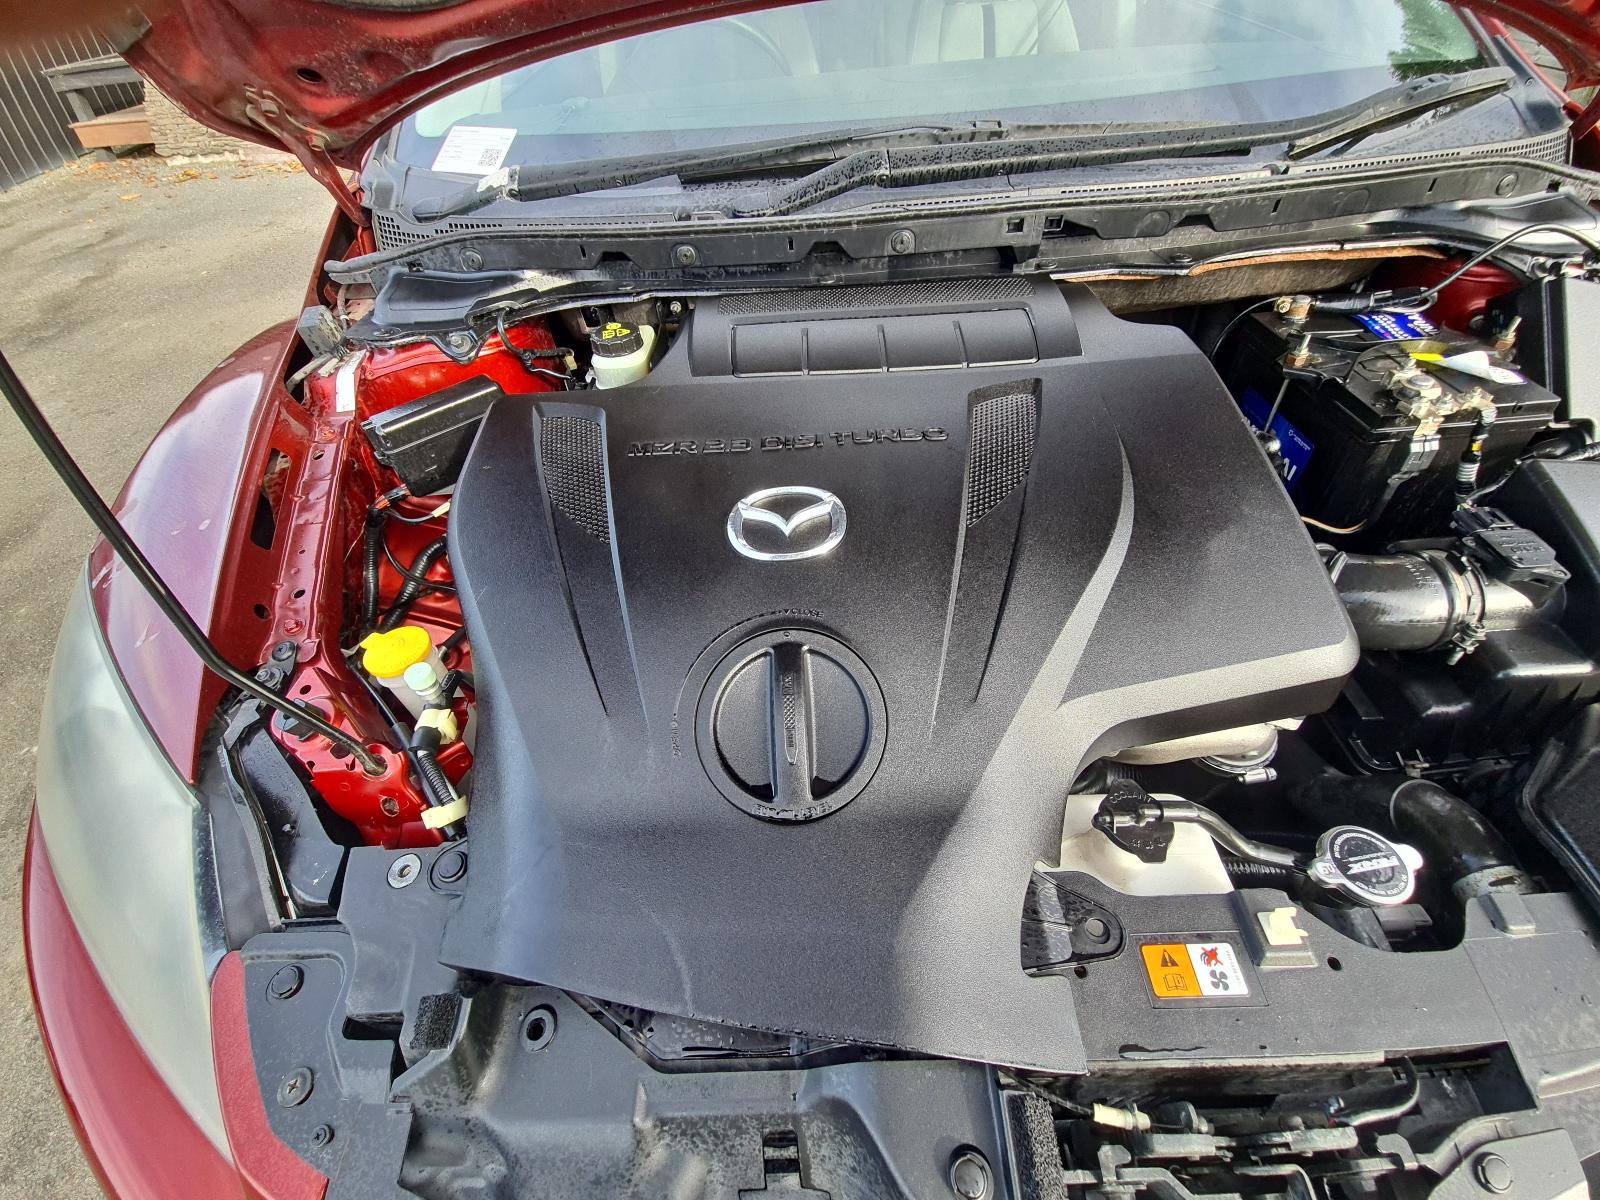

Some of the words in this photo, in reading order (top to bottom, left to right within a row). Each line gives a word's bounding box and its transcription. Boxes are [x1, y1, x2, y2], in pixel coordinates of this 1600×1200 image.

[627, 441, 698, 456] MZR
[702, 438, 752, 454] 2.3
[828, 426, 949, 446] TURBO
